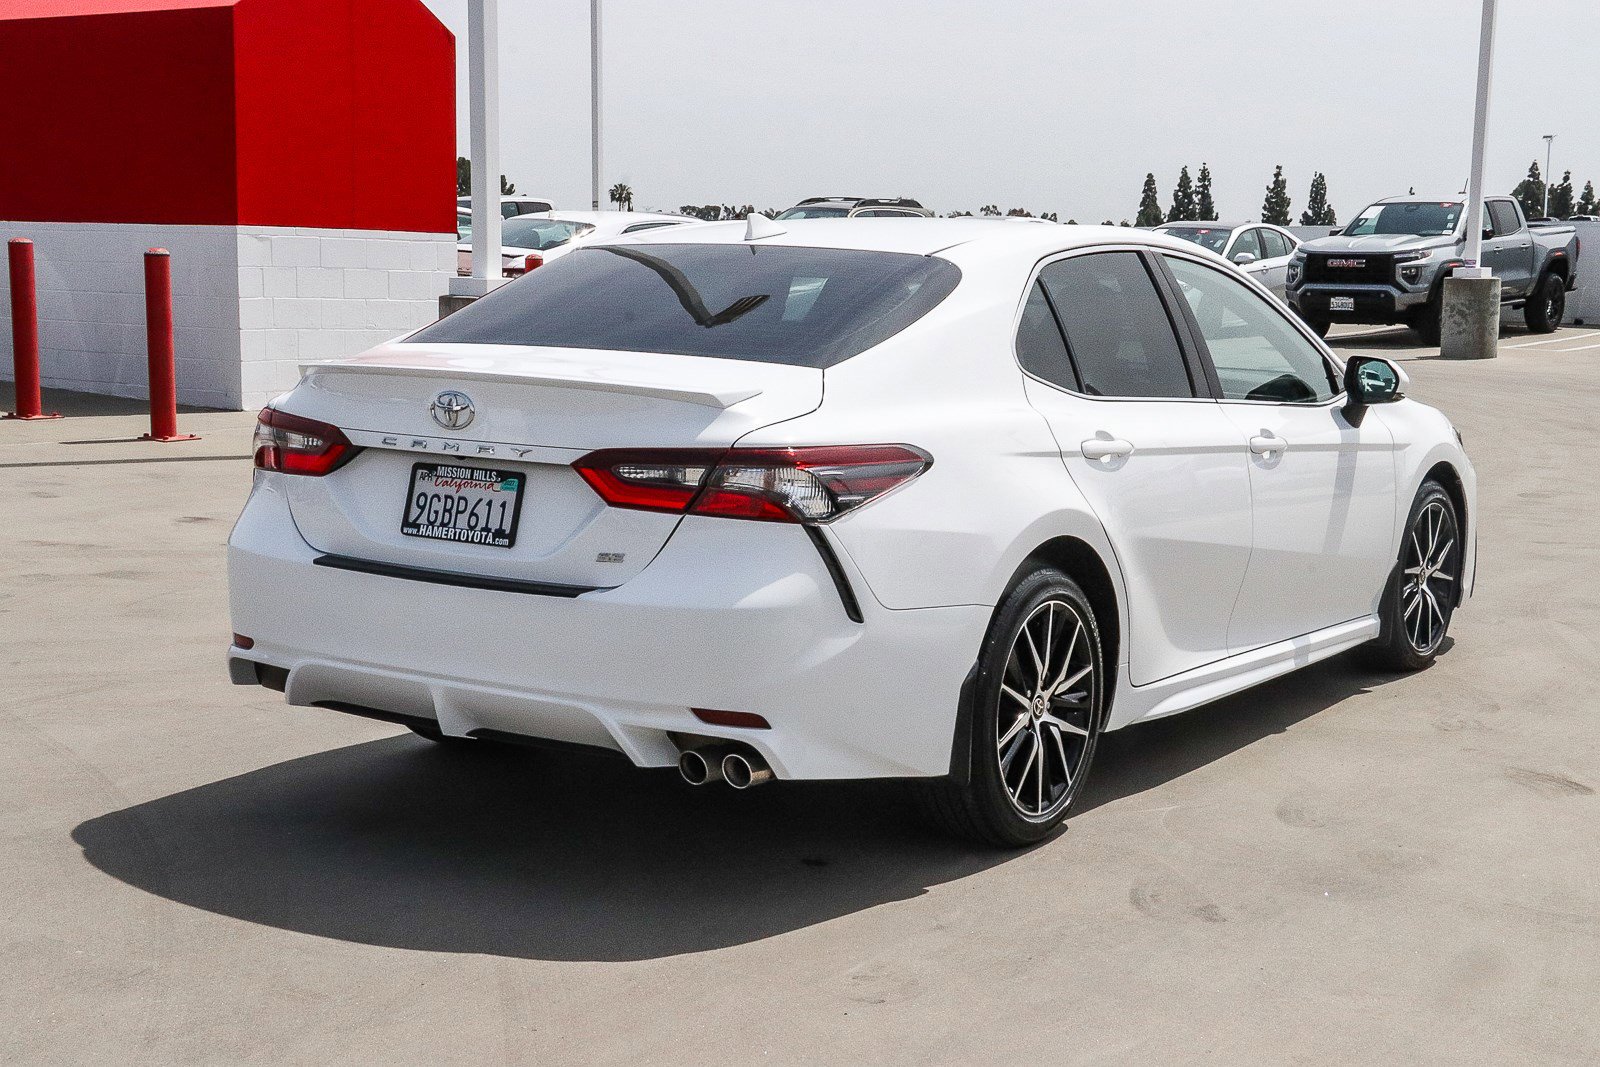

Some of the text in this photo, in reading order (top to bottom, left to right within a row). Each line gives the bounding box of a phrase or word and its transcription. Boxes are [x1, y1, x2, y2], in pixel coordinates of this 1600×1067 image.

[1327, 259, 1366, 268] GMC
[381, 437, 533, 457] CAMRY
[419, 471, 433, 481] APR
[436, 466, 498, 482] MISSION HILLS
[434, 476, 502, 494] California
[411, 491, 507, 533] 9GBP611
[403, 525, 509, 546] www.HAMERTOYOTA.com
